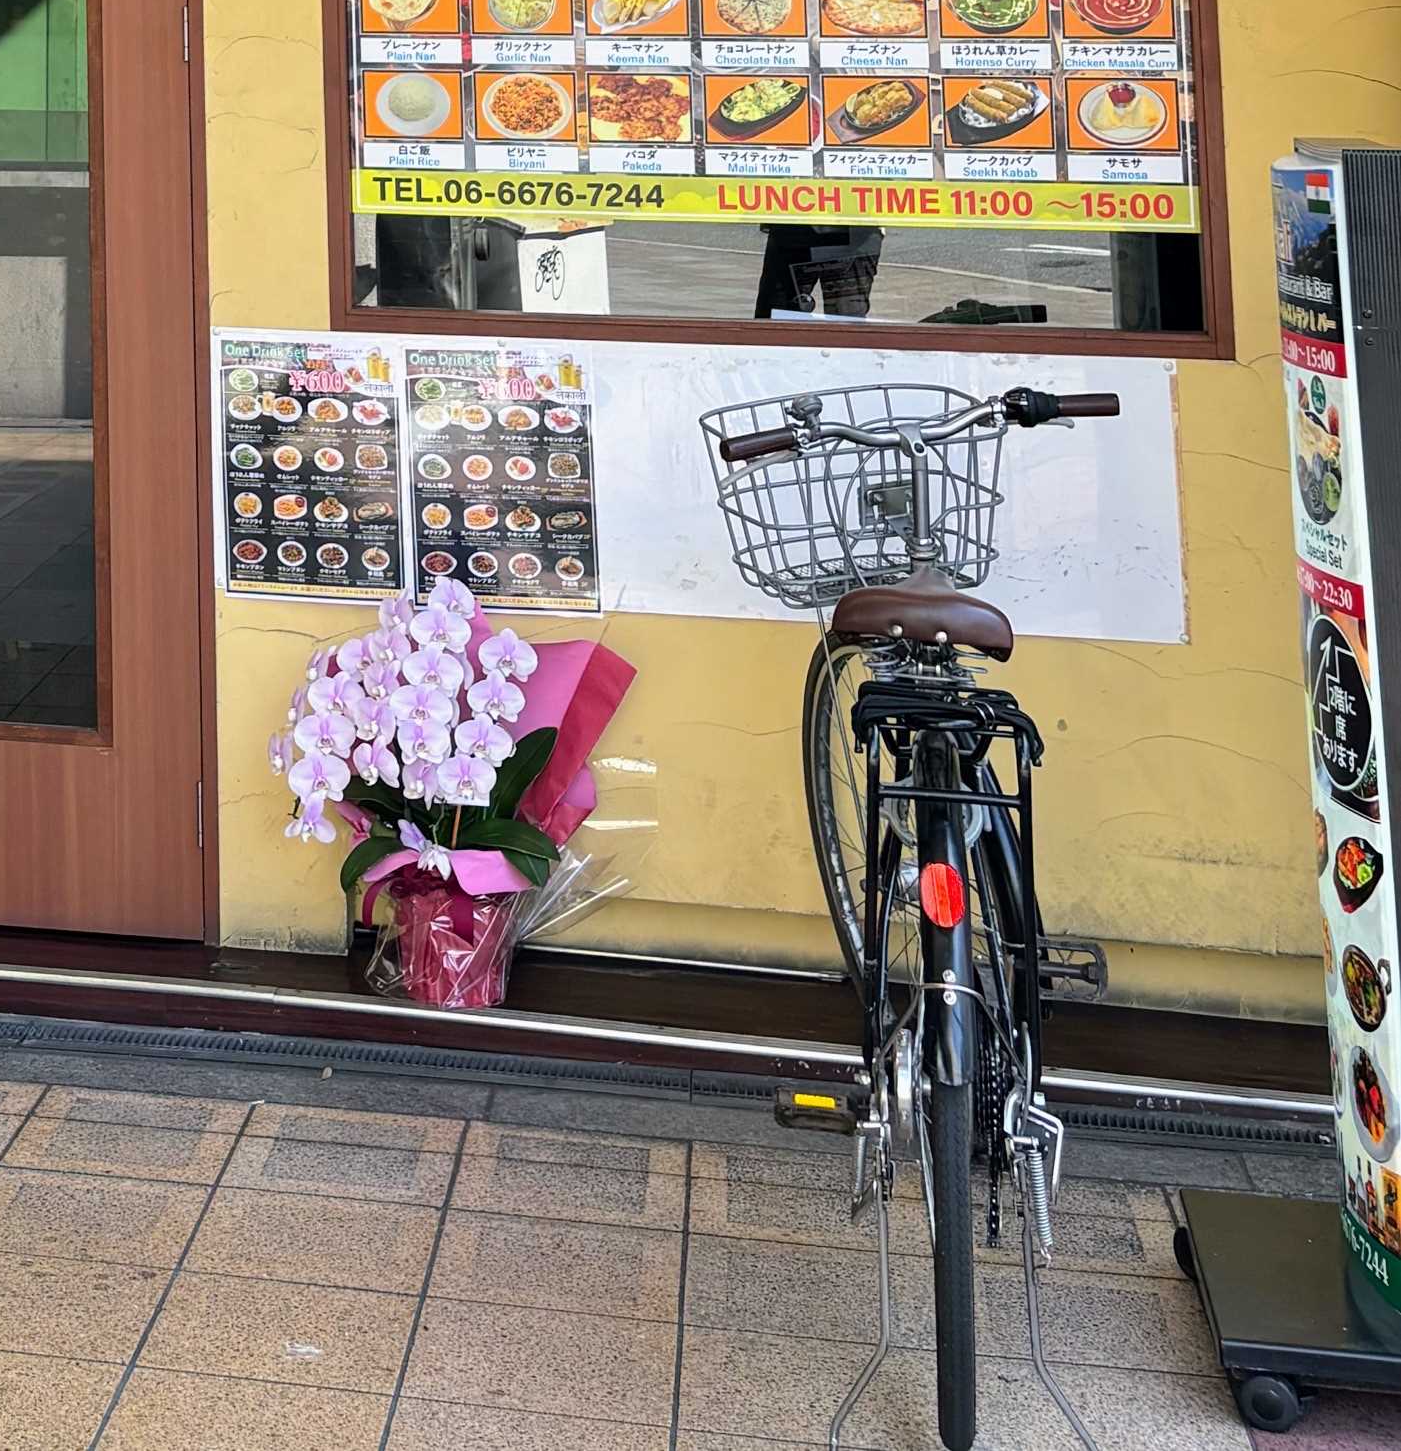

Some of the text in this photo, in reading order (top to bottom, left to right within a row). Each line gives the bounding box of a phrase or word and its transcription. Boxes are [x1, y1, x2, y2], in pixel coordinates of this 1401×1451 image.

[386, 51, 437, 61] Plain Nan
[496, 52, 552, 63] Garlic Nan
[607, 53, 670, 64] Keema Nan
[714, 55, 796, 65] Chocolate Nan
[840, 55, 908, 66] Cheese Nan
[955, 57, 1037, 70] Horenso Curry
[1064, 57, 1177, 69] Chicken Masala Curry
[388, 156, 440, 167] Plain Rice
[508, 157, 546, 170] Biryani
[622, 160, 663, 172] Pakoda
[1105, 157, 1143, 168] サモサ
[727, 163, 792, 174] Malai Tikka
[849, 164, 908, 175] Fish Tikka
[962, 166, 1039, 178] Seekh Kabab
[1101, 168, 1149, 180] Samosa
[372, 176, 666, 209] TEL.06-6676-7244
[717, 183, 841, 214] LUNCH
[850, 187, 941, 215] TIME
[949, 190, 1034, 217] 11:00
[225, 344, 249, 358] One
[409, 353, 436, 366] One
[1328, 548, 1344, 570] Set
